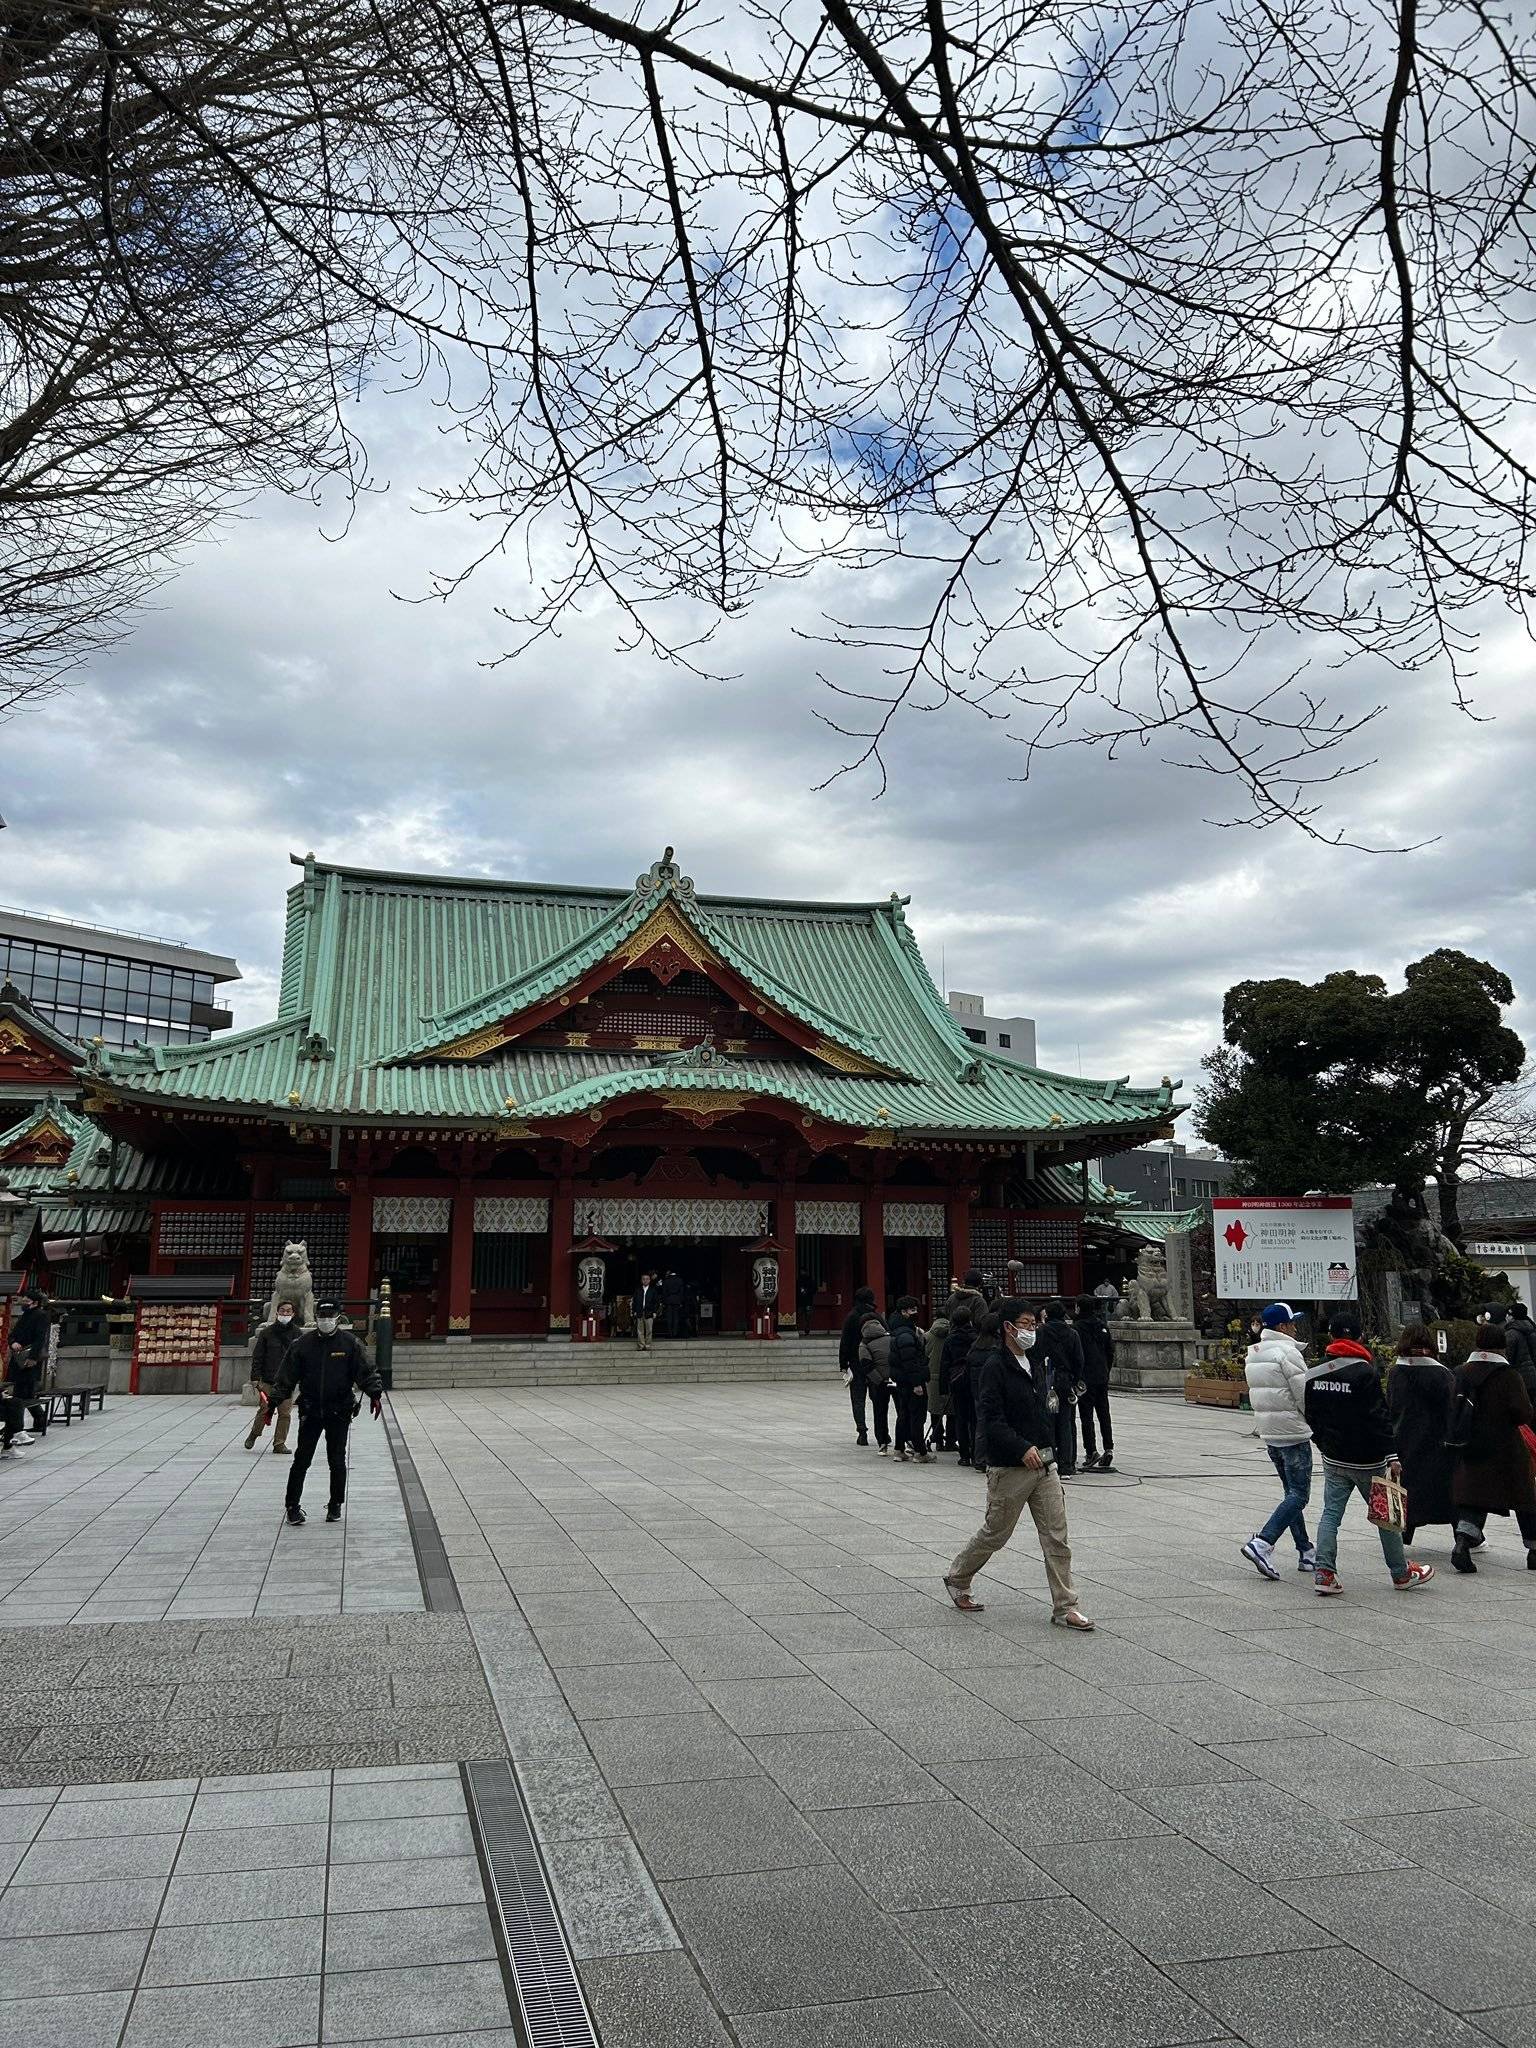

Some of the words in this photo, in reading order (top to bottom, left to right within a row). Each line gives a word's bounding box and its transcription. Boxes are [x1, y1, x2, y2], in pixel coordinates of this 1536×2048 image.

[1260, 1228, 1296, 1237] 神田明神
[587, 1266, 602, 1299] 神田明神
[762, 1266, 776, 1298] 神田明神
[1312, 1380, 1329, 1391] JUST
[1329, 1381, 1341, 1392] DO
